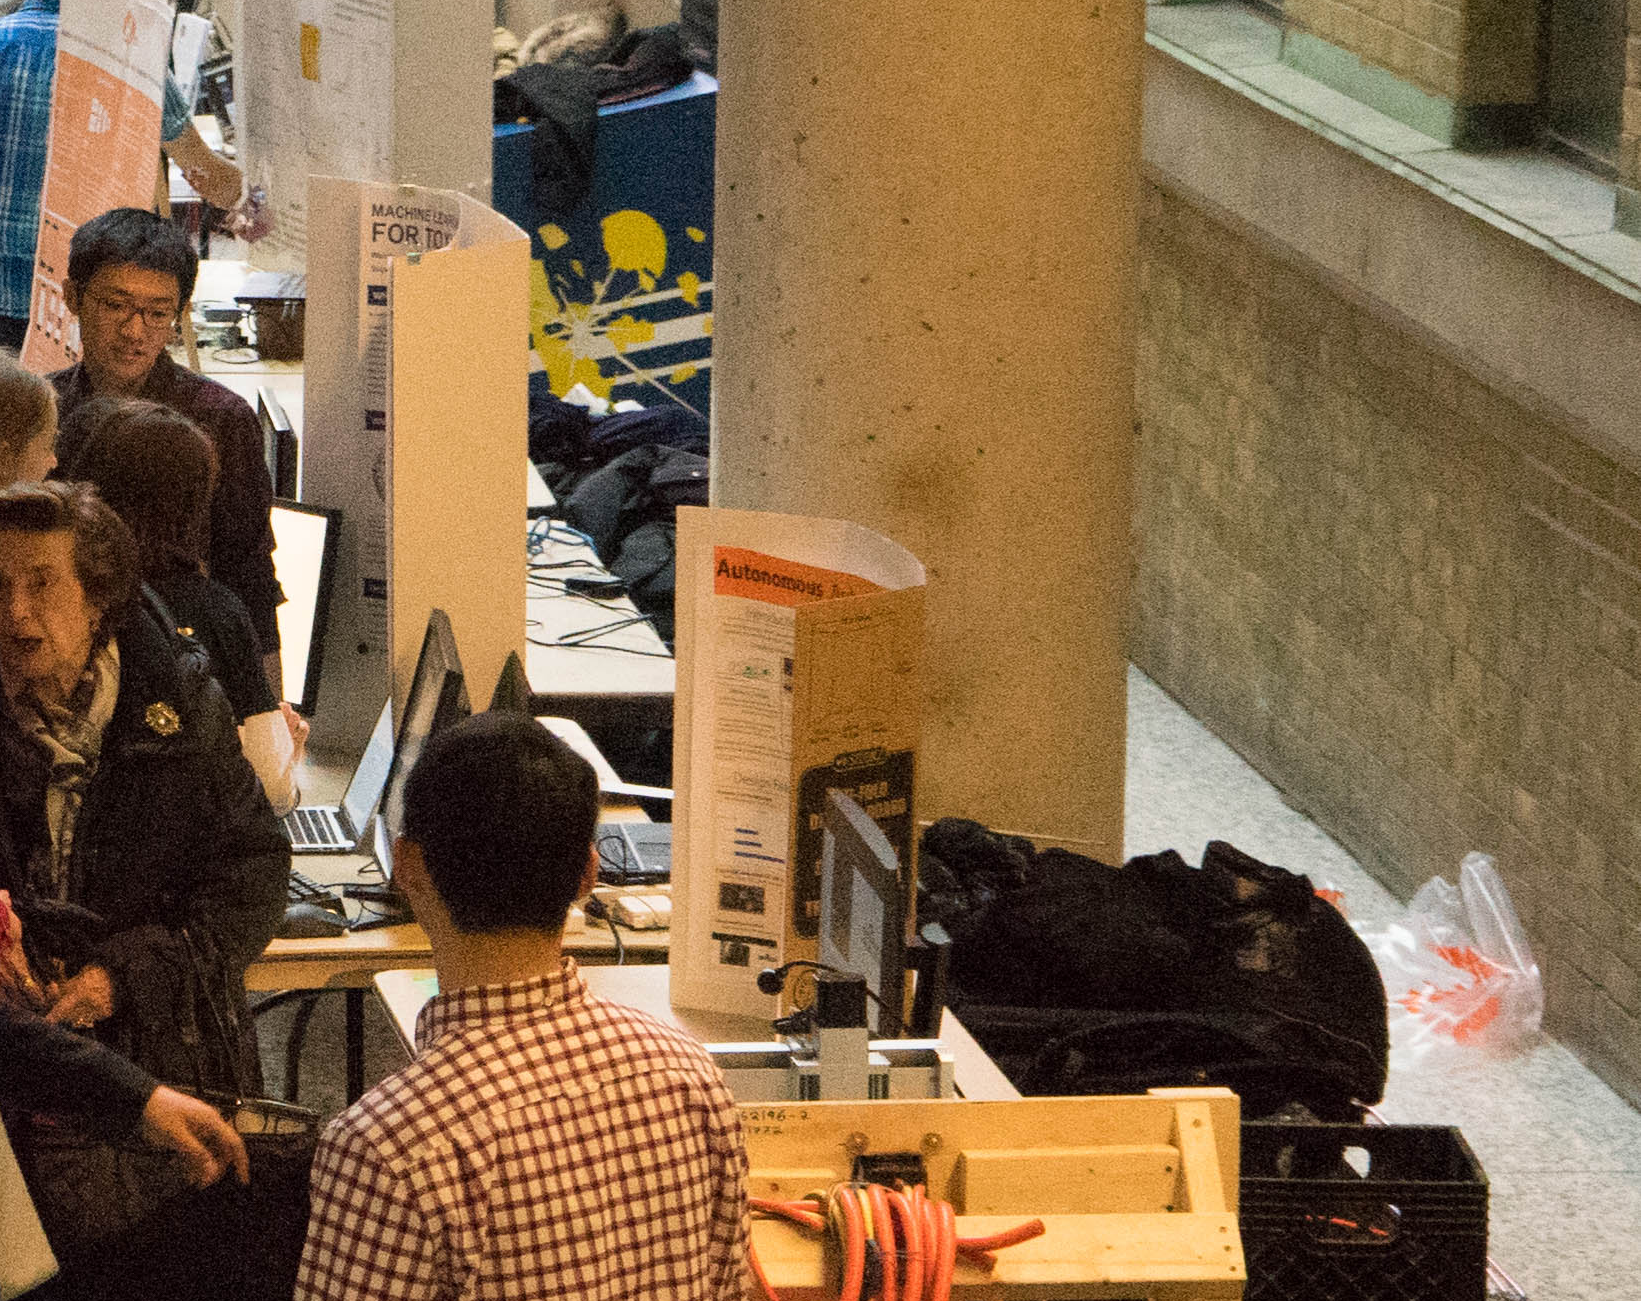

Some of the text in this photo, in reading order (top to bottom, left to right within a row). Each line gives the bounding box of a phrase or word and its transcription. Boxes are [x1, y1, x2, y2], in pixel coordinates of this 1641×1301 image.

[371, 204, 432, 221] MACHINE
[371, 222, 419, 244] FOR
[717, 558, 824, 597] Autonomous
